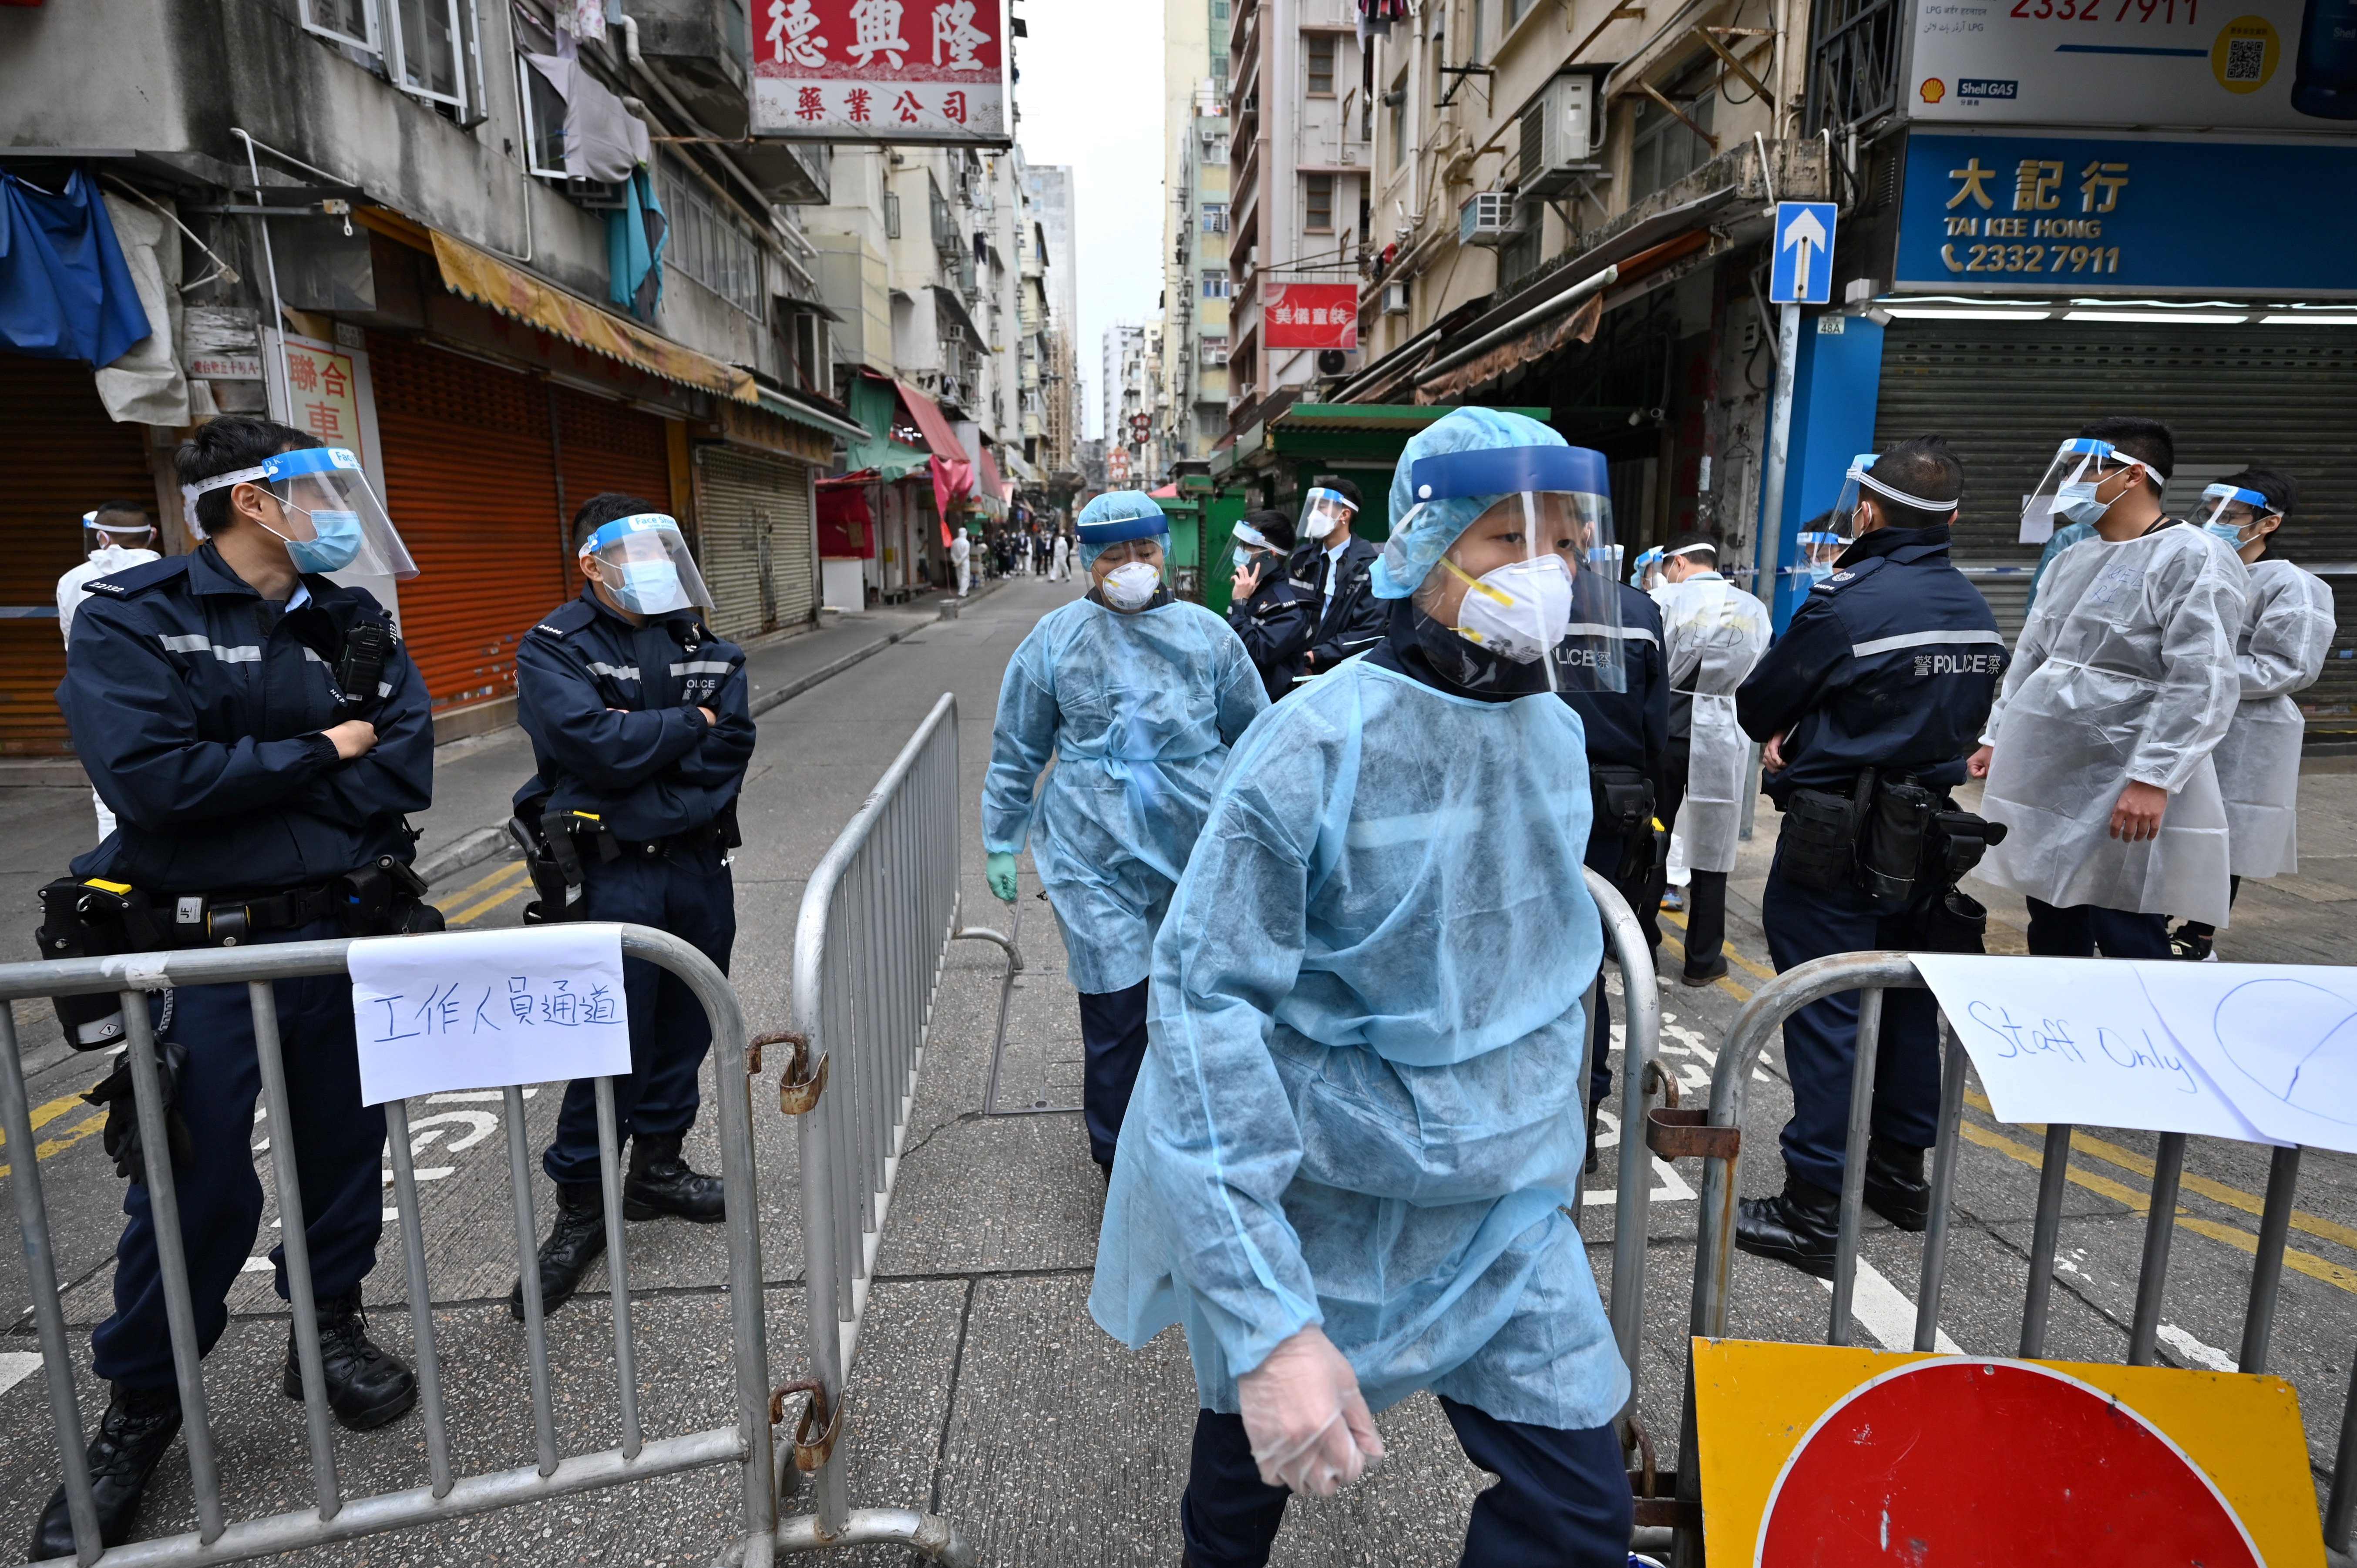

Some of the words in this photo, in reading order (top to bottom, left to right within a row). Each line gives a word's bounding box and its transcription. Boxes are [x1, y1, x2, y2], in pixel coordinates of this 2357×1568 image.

[1926, 6, 1942, 14] LPG
[2333, 27, 2357, 38] Shell
[1961, 82, 1987, 94] Shell
[1988, 83, 2014, 96] GAS
[795, 87, 967, 124] 藥業公司
[1946, 158, 2129, 212] 大記行
[1944, 217, 1978, 236] TAI
[1984, 218, 2028, 237] KEE
[2033, 218, 2102, 238] HONG
[1966, 244, 2044, 272] 2332
[2050, 245, 2119, 273] 7911
[1821, 323, 1840, 333] 48A
[287, 353, 348, 398] 聯合
[305, 401, 344, 445] 車
[264, 457, 283, 467] D.K.
[88, 581, 124, 592] 22132
[1914, 655, 1932, 676] 警
[1933, 654, 1987, 674] POLICE
[1987, 653, 2001, 675] 察
[686, 679, 715, 688] OLICE
[330, 688, 345, 703] HKP
[374, 976, 626, 1043] 工作人員通道
[1968, 1001, 2086, 1063] Staff
[2098, 1027, 2198, 1094] Only
